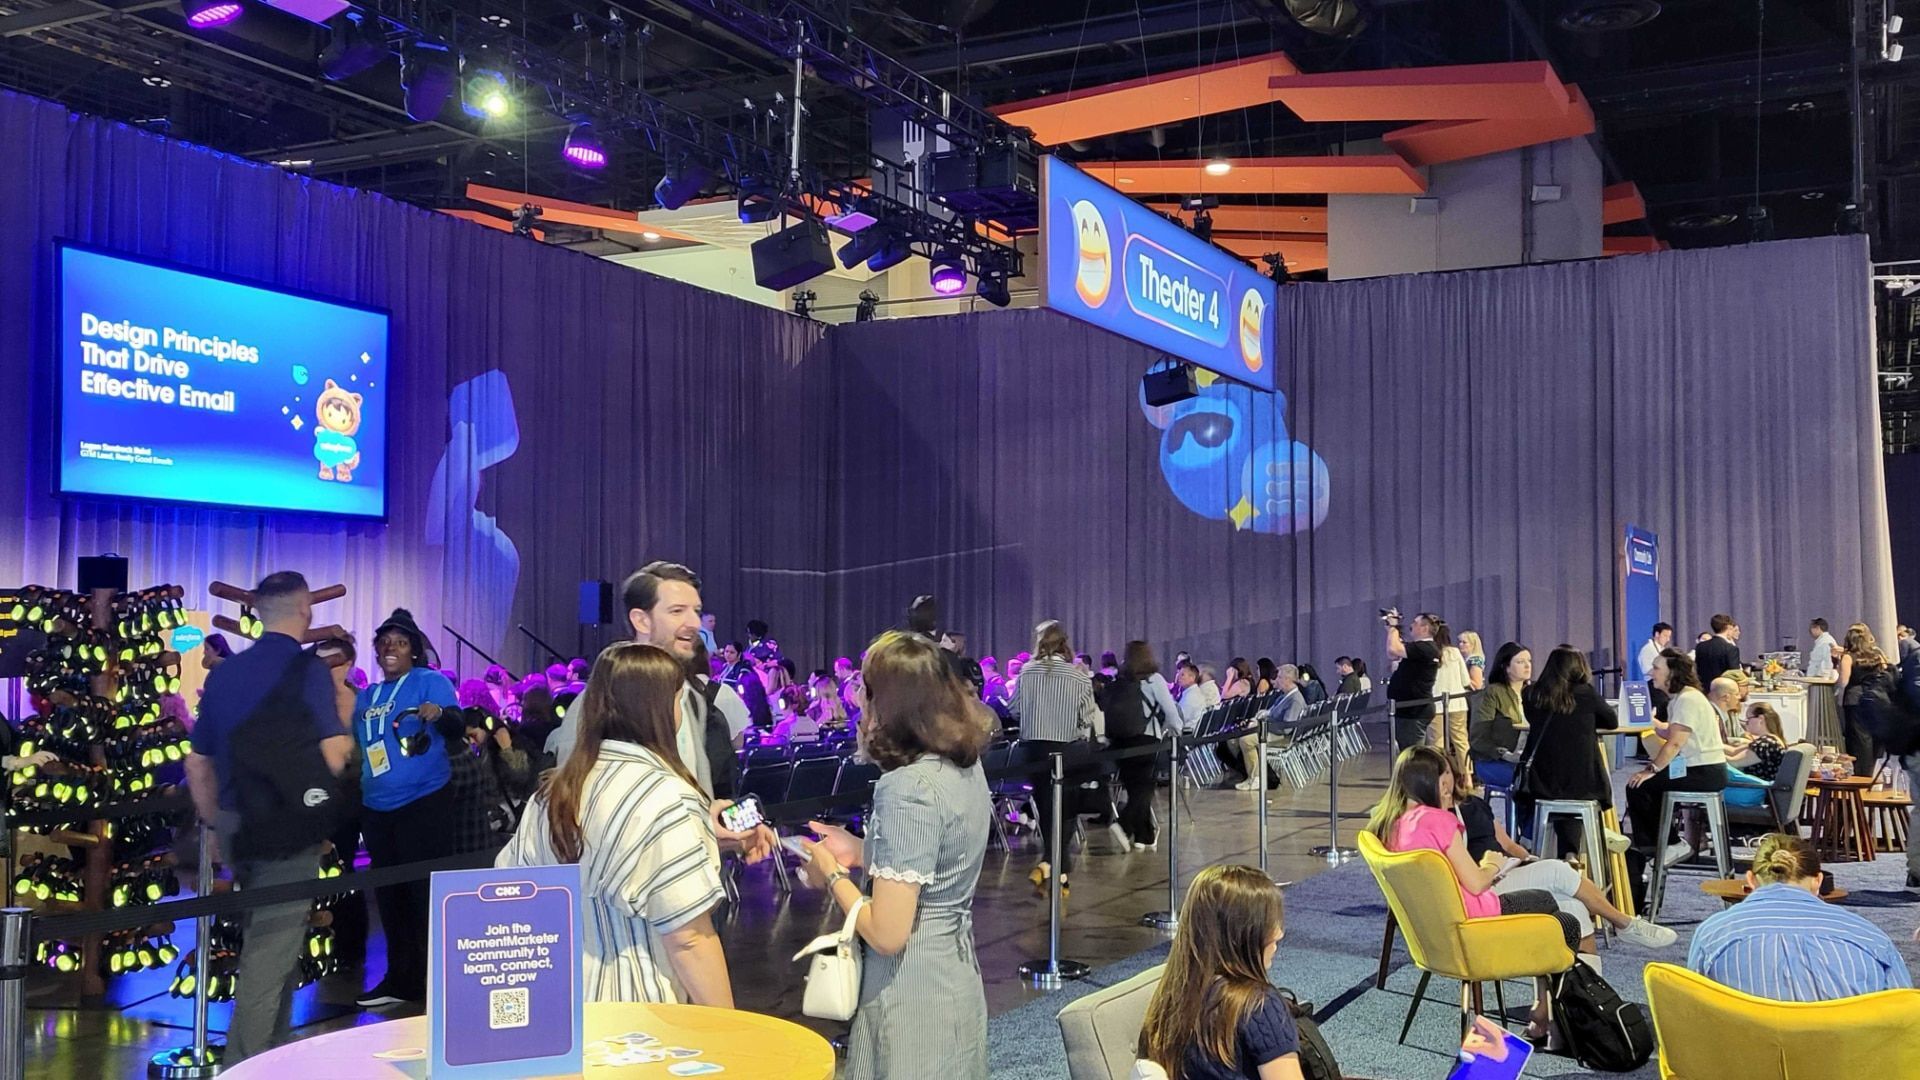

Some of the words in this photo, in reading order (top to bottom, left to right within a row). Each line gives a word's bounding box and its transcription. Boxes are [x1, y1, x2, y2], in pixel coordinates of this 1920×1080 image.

[1139, 254, 1205, 324] Theater
[1208, 290, 1219, 329] 4
[81, 312, 158, 349] Design
[163, 327, 259, 364] Principles
[81, 341, 130, 370] That
[134, 352, 189, 379] Drive
[81, 370, 175, 404] Effective
[180, 385, 235, 412] Email
[495, 886, 520, 897] CNX
[484, 924, 509, 936] Join
[512, 923, 531, 933] the
[457, 933, 559, 950] MomentMarketer
[467, 946, 534, 962] community
[537, 945, 549, 957] to
[464, 963, 498, 975] learn,
[500, 958, 553, 972] connect,
[480, 973, 505, 985] and
[507, 971, 537, 986] grow
